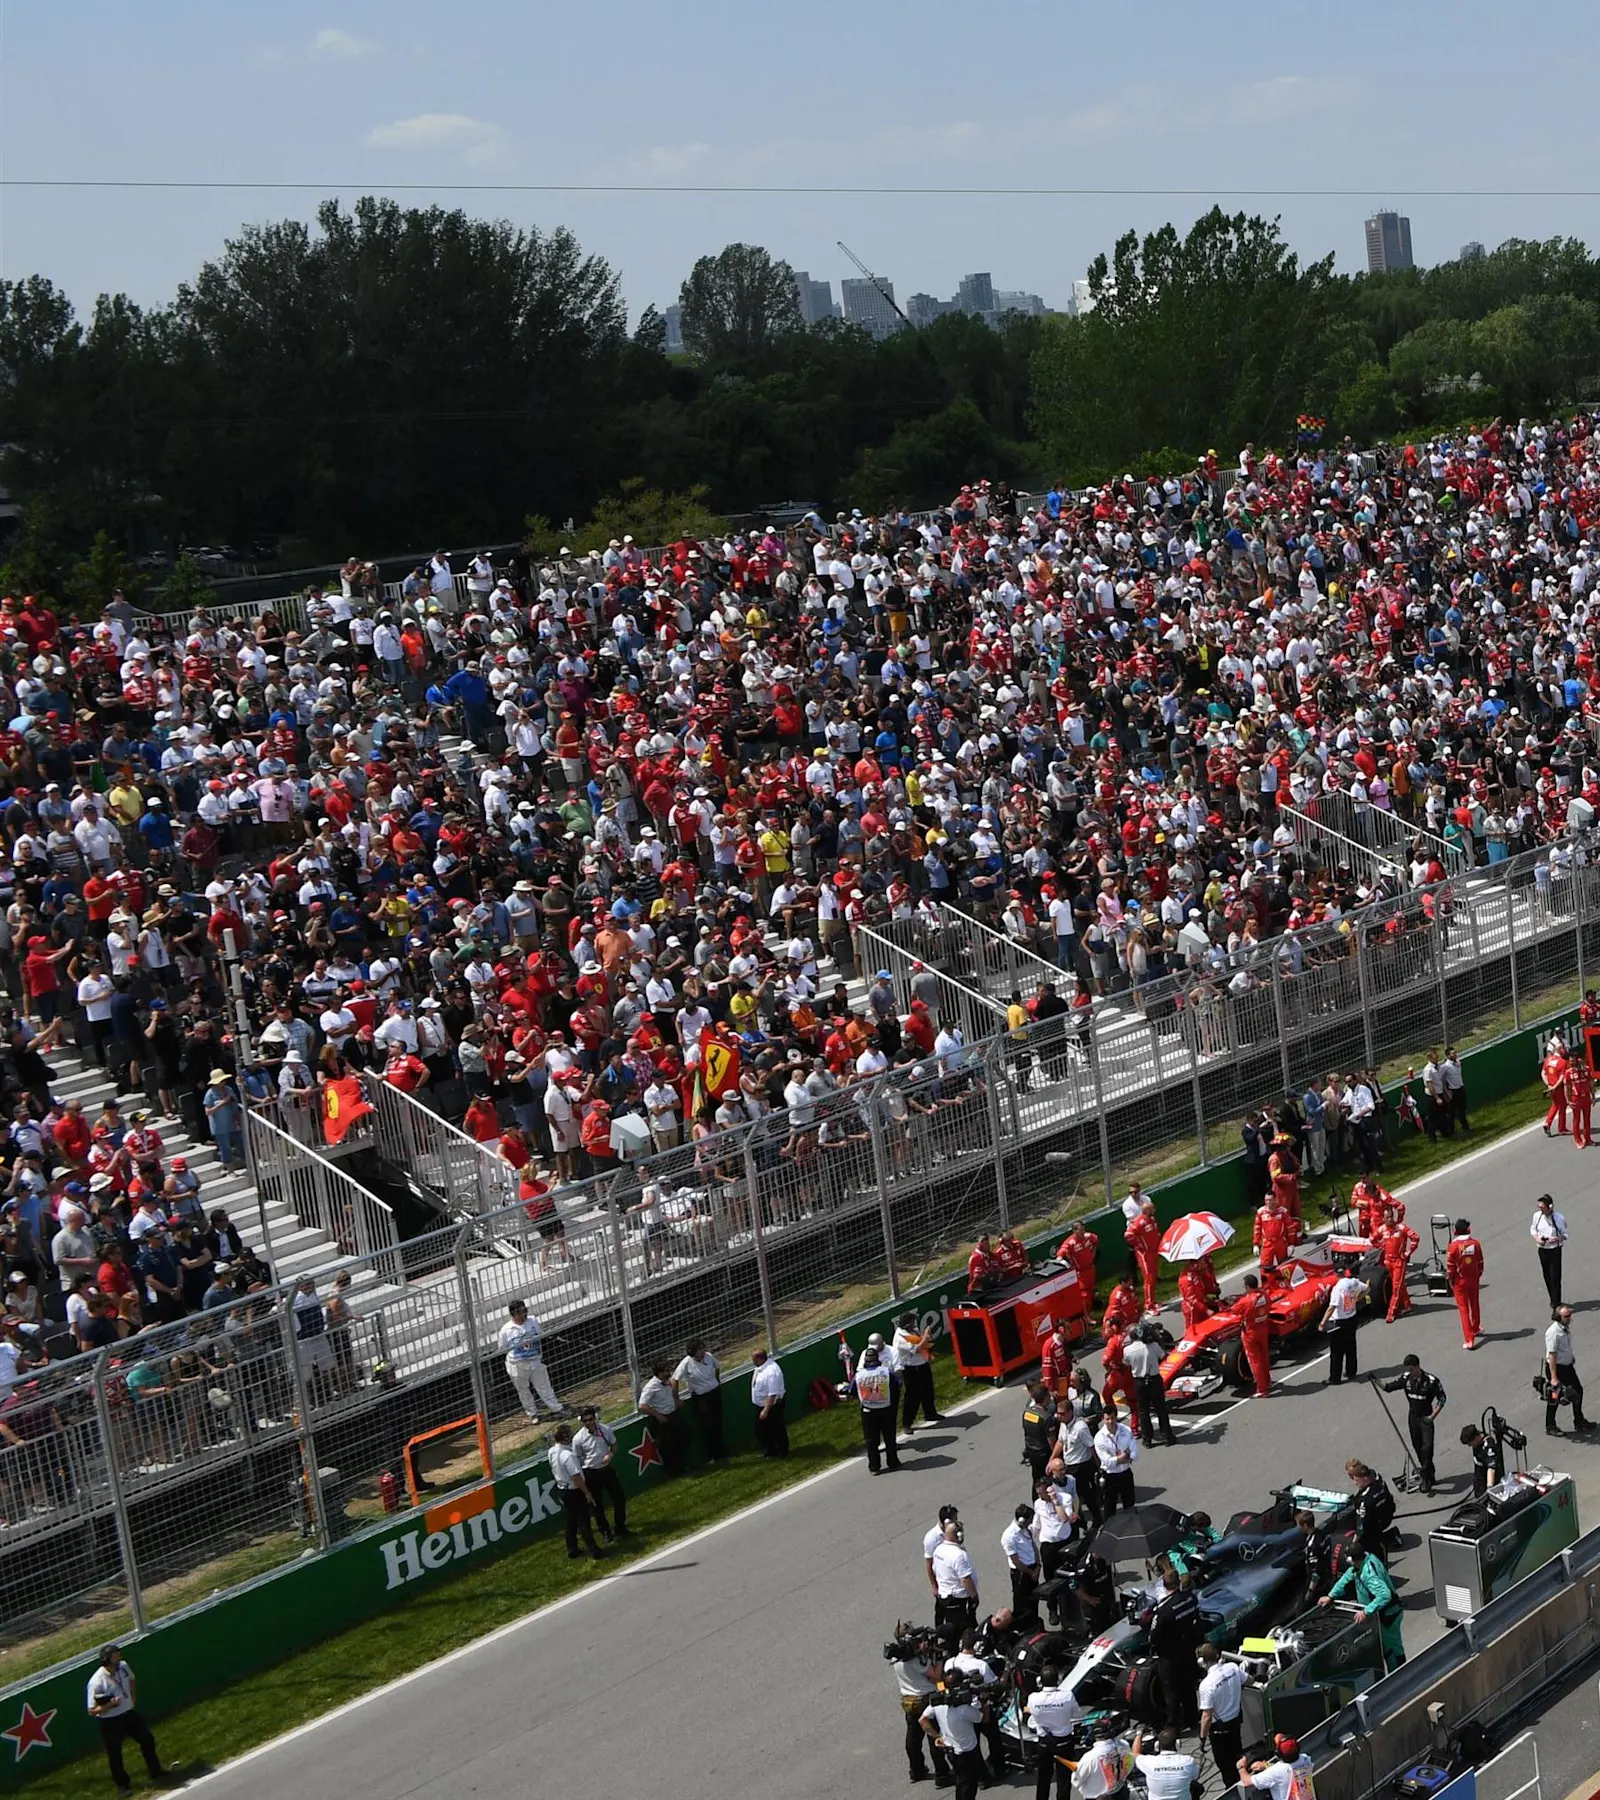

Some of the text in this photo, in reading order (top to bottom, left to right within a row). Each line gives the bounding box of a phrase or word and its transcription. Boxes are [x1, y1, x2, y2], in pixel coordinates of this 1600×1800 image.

[1292, 1487, 1349, 1501] PETRONAS
[380, 1477, 564, 1590] Heinek
[1093, 1637, 1114, 1649] 44
